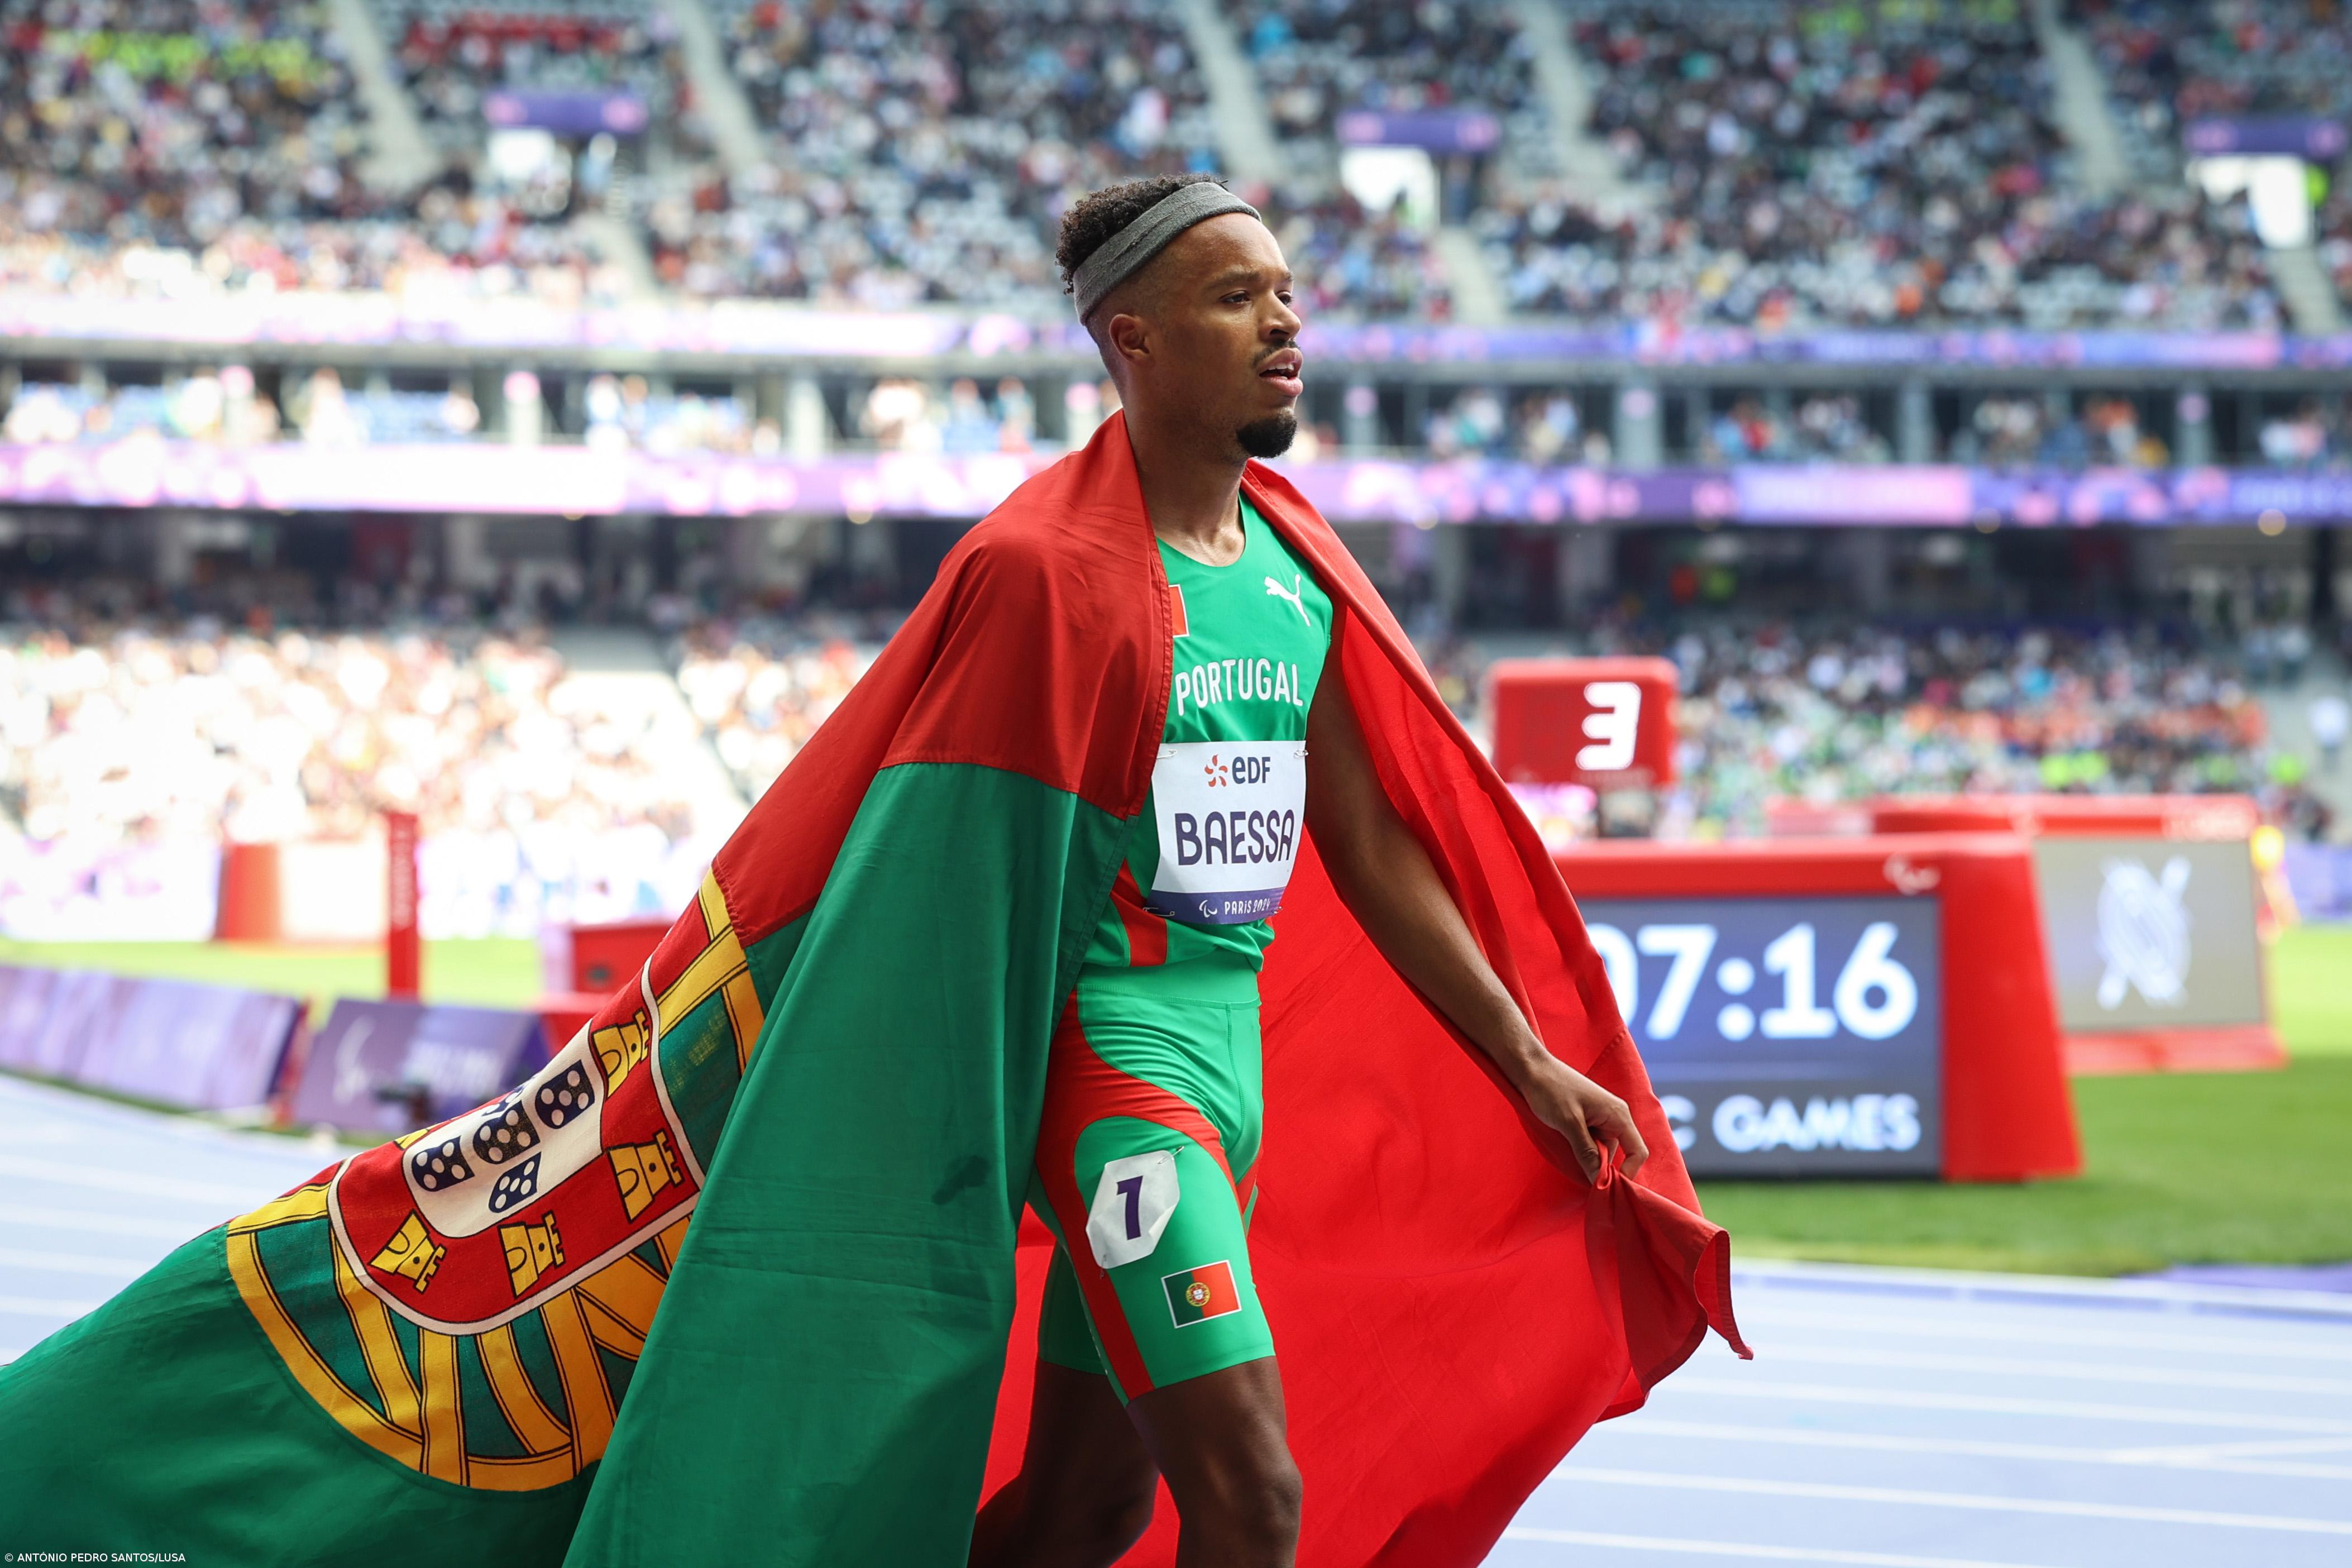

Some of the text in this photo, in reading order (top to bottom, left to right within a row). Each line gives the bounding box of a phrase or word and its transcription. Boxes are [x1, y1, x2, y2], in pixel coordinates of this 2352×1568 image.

[1175, 658, 1303, 716] PORTUGAL
[1575, 682, 1641, 771] 3
[1175, 809, 1294, 866] BAESSA
[1253, 898, 1270, 912] 2024
[1713, 1094, 1921, 1152] GAMES
[1116, 1175, 1143, 1240] 1
